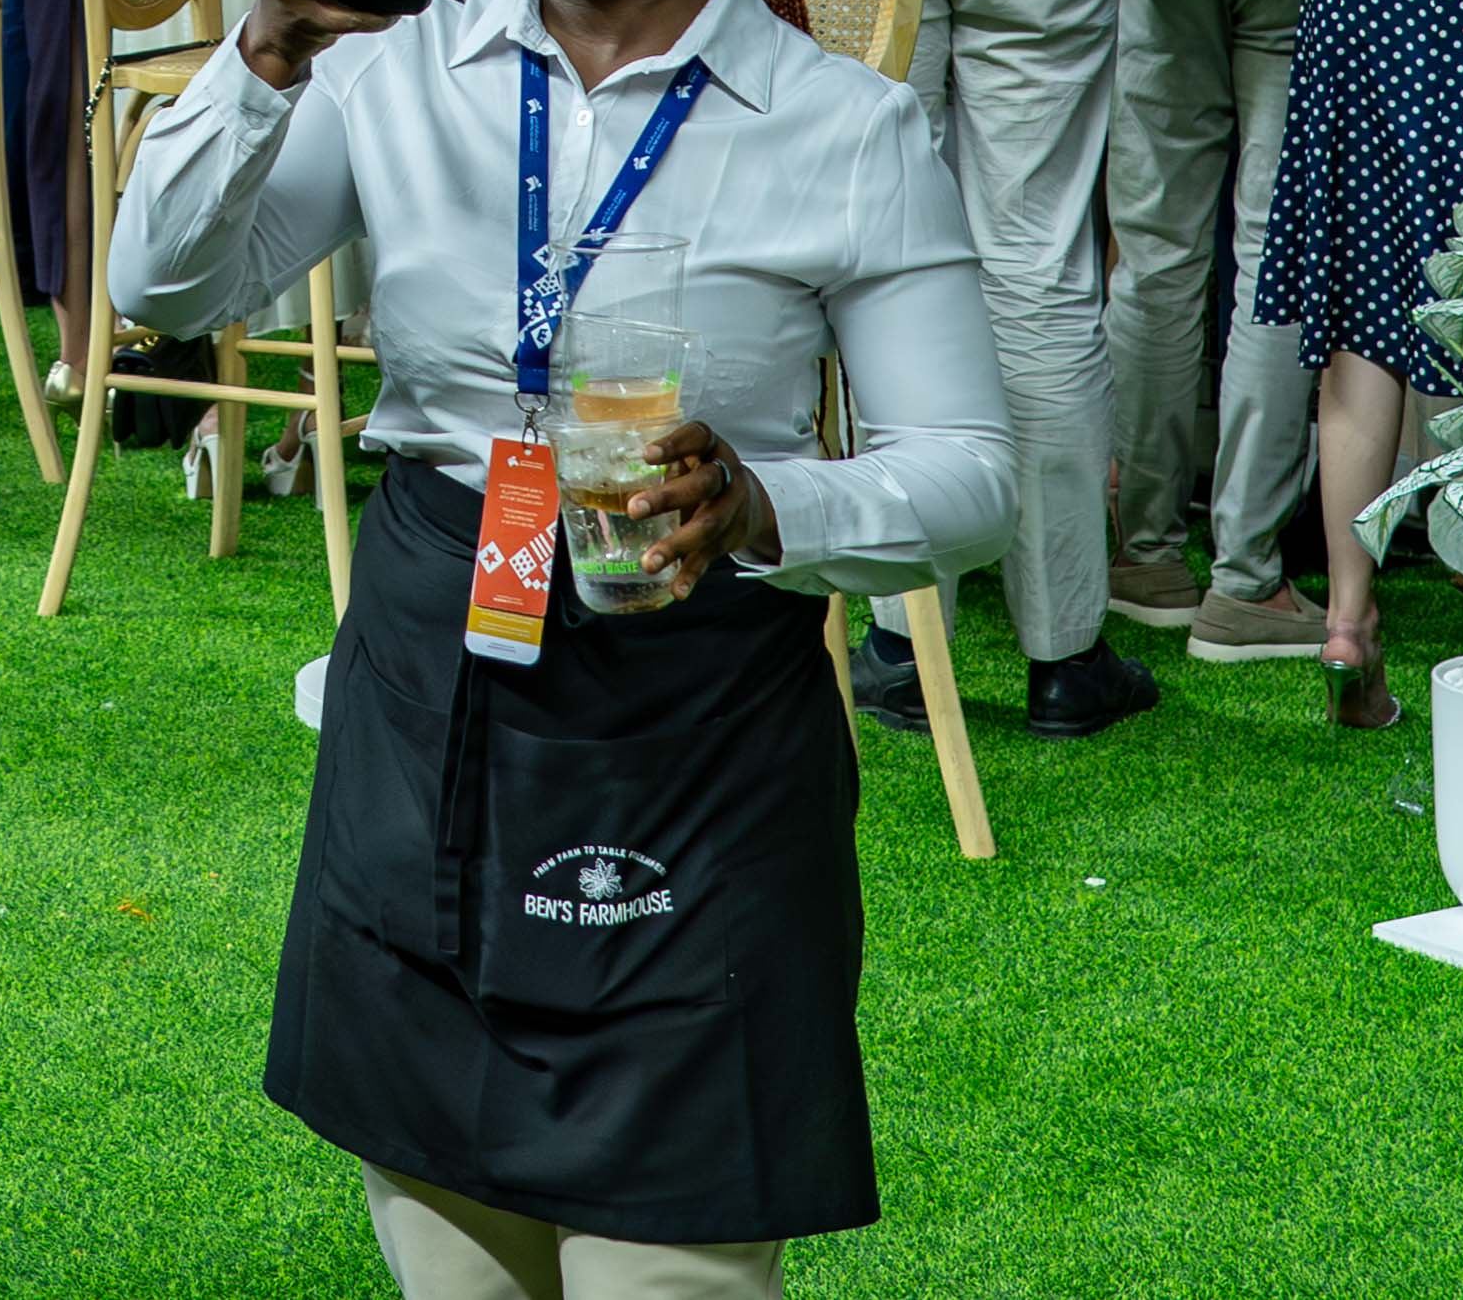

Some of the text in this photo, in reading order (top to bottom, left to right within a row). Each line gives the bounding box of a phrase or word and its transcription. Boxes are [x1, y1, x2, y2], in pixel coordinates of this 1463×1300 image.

[556, 847, 582, 864] FARM
[583, 845, 596, 856] TO
[597, 845, 627, 859] TABLE
[524, 888, 675, 927] BEN'S FARMHOUSE
